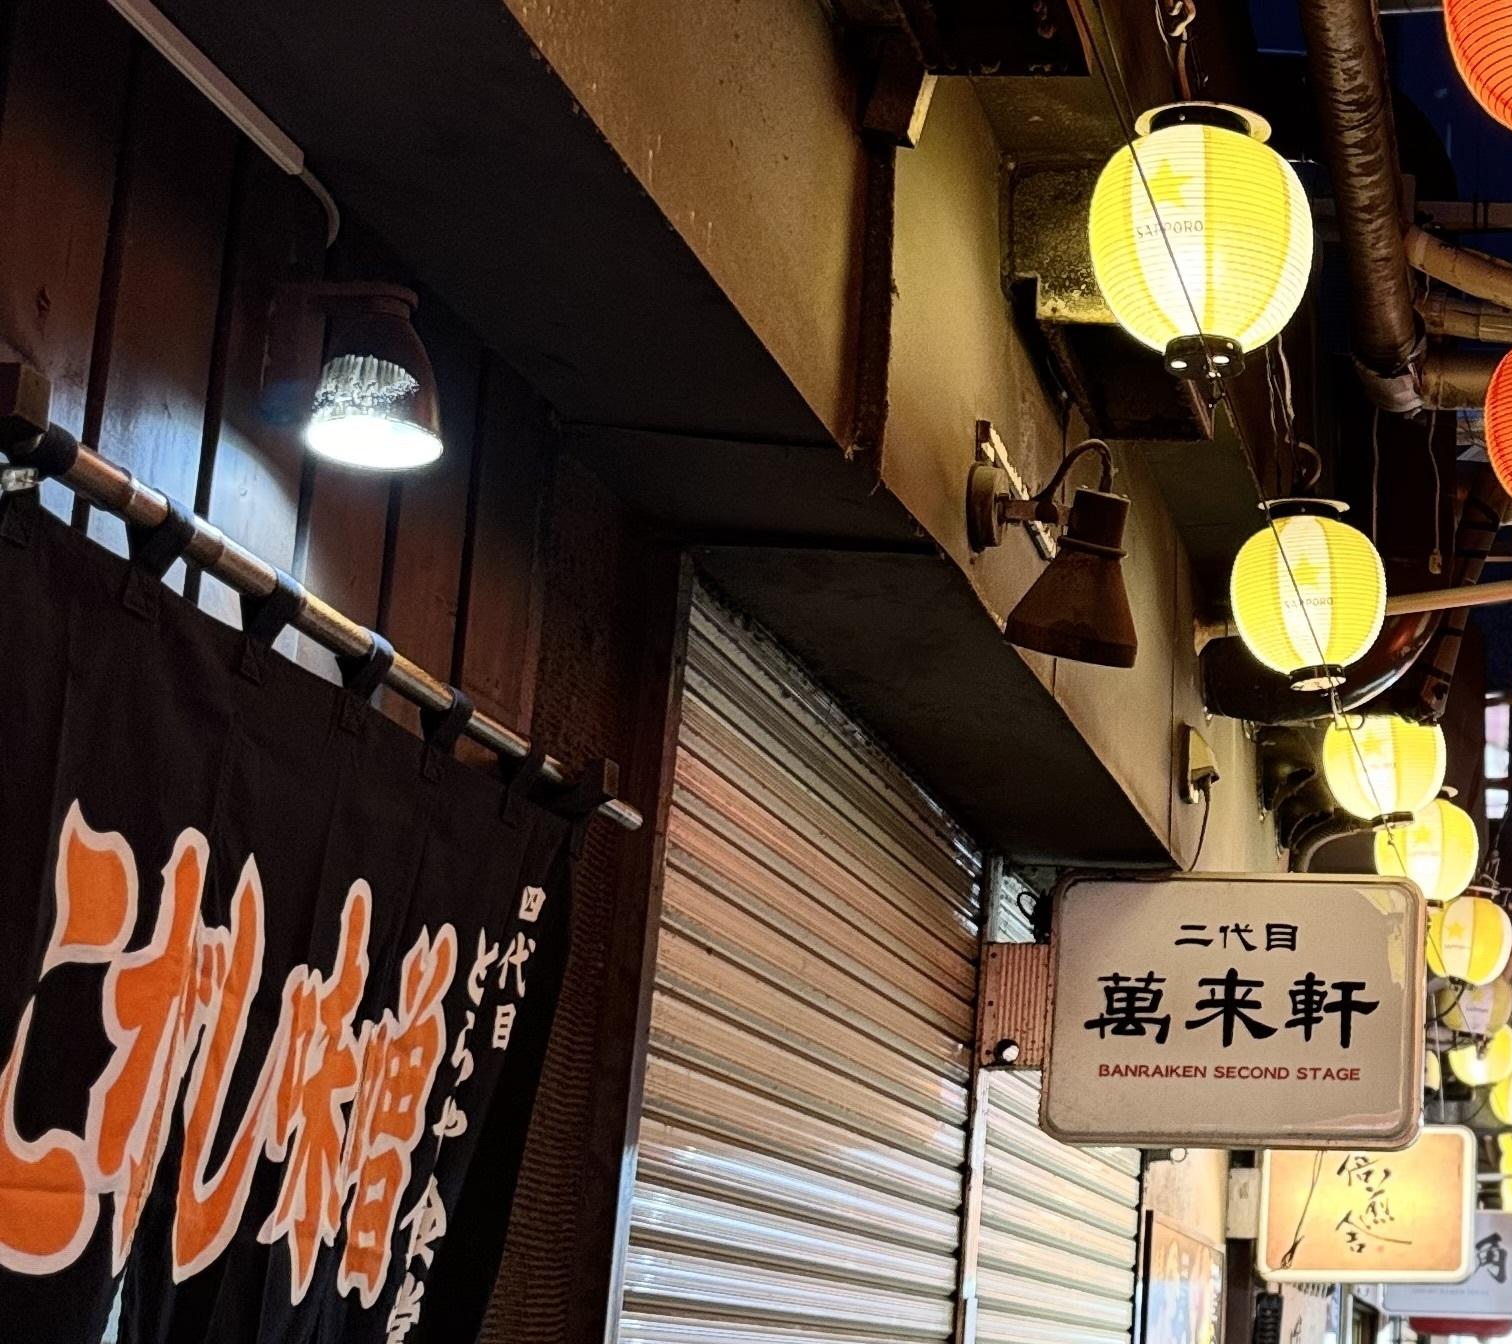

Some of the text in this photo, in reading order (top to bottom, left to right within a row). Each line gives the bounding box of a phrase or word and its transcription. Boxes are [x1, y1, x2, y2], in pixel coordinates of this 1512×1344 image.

[1174, 923, 1299, 952] 二代目
[493, 886, 545, 1050] 四代目
[1084, 968, 1380, 1049] 萬来軒
[1098, 1064, 1361, 1081] BANRAIKEN SECOND STAGE
